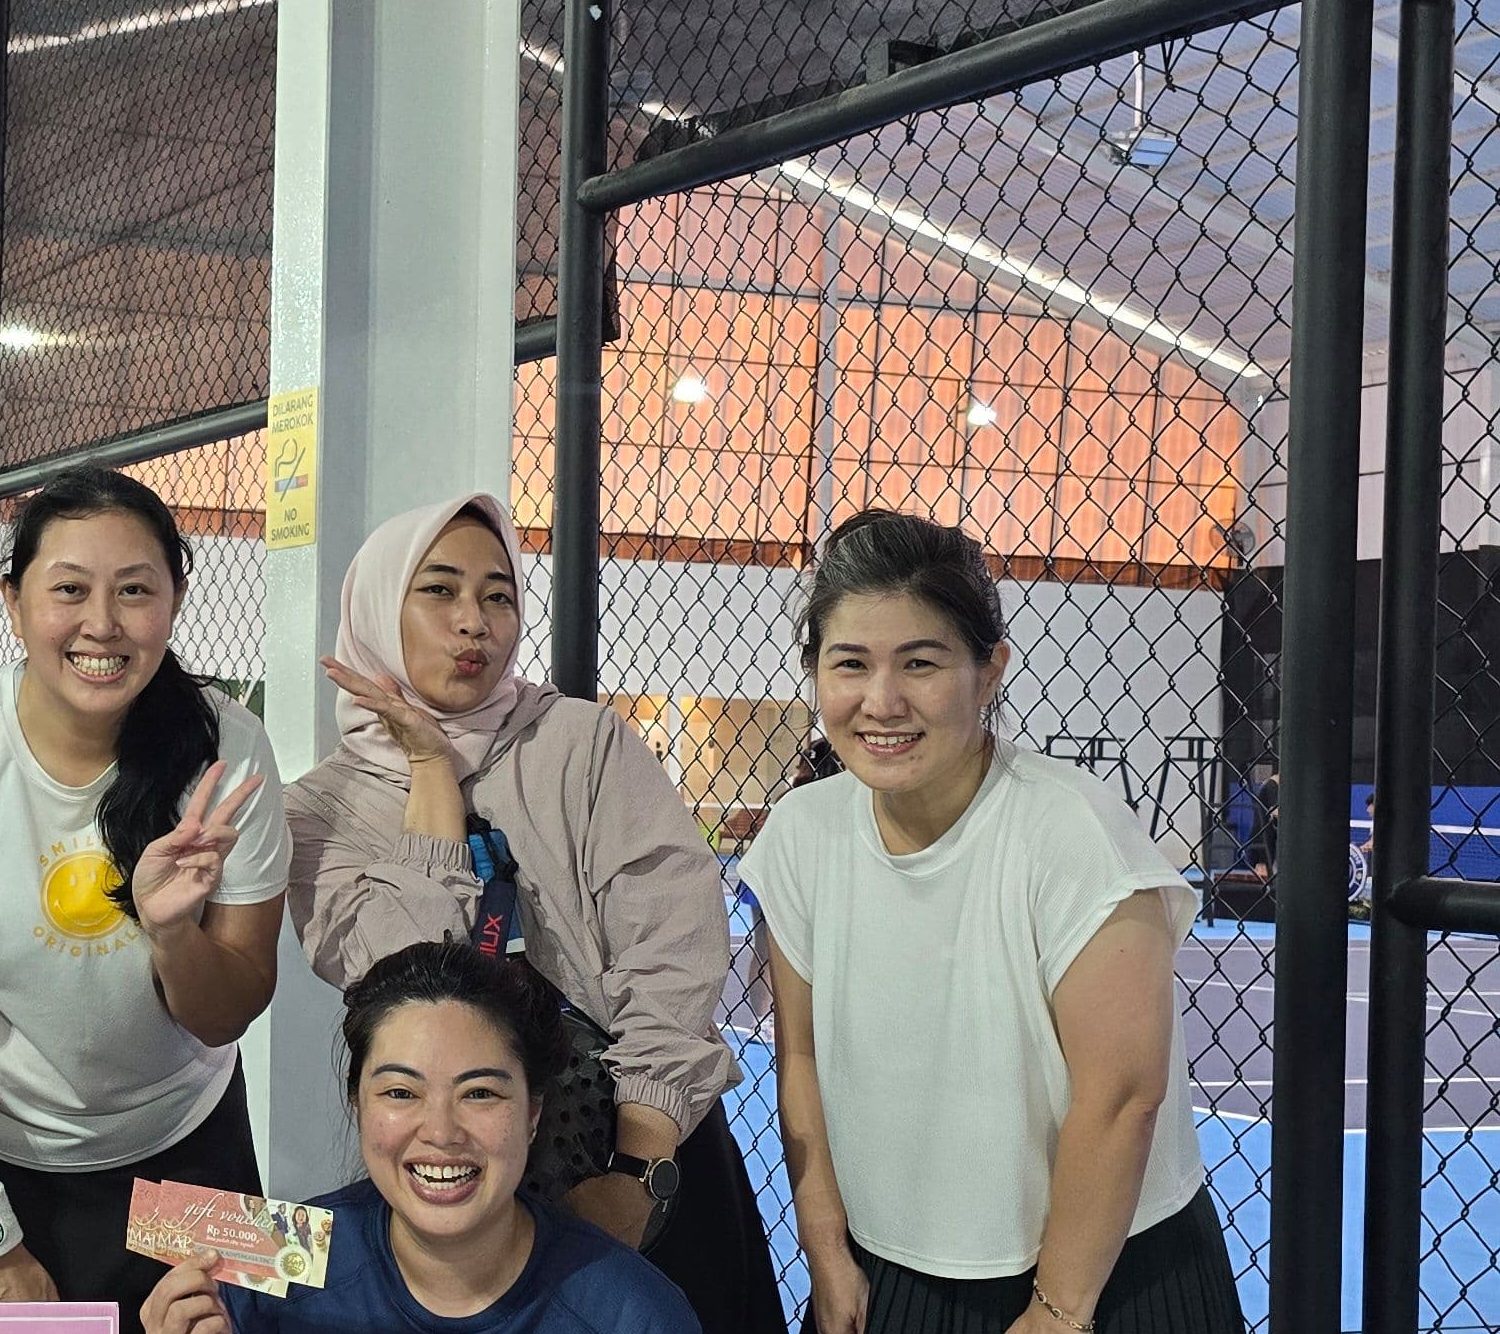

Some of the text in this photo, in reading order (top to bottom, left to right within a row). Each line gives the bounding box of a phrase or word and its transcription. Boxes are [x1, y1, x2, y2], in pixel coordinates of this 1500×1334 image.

[272, 394, 314, 417] DILARANG
[271, 415, 314, 434] MEROKOK
[284, 507, 298, 521] NO
[271, 523, 310, 542] SMOKING
[39, 835, 107, 867] SMIL
[162, 1192, 225, 1234] gift
[206, 1224, 220, 1237] Rp
